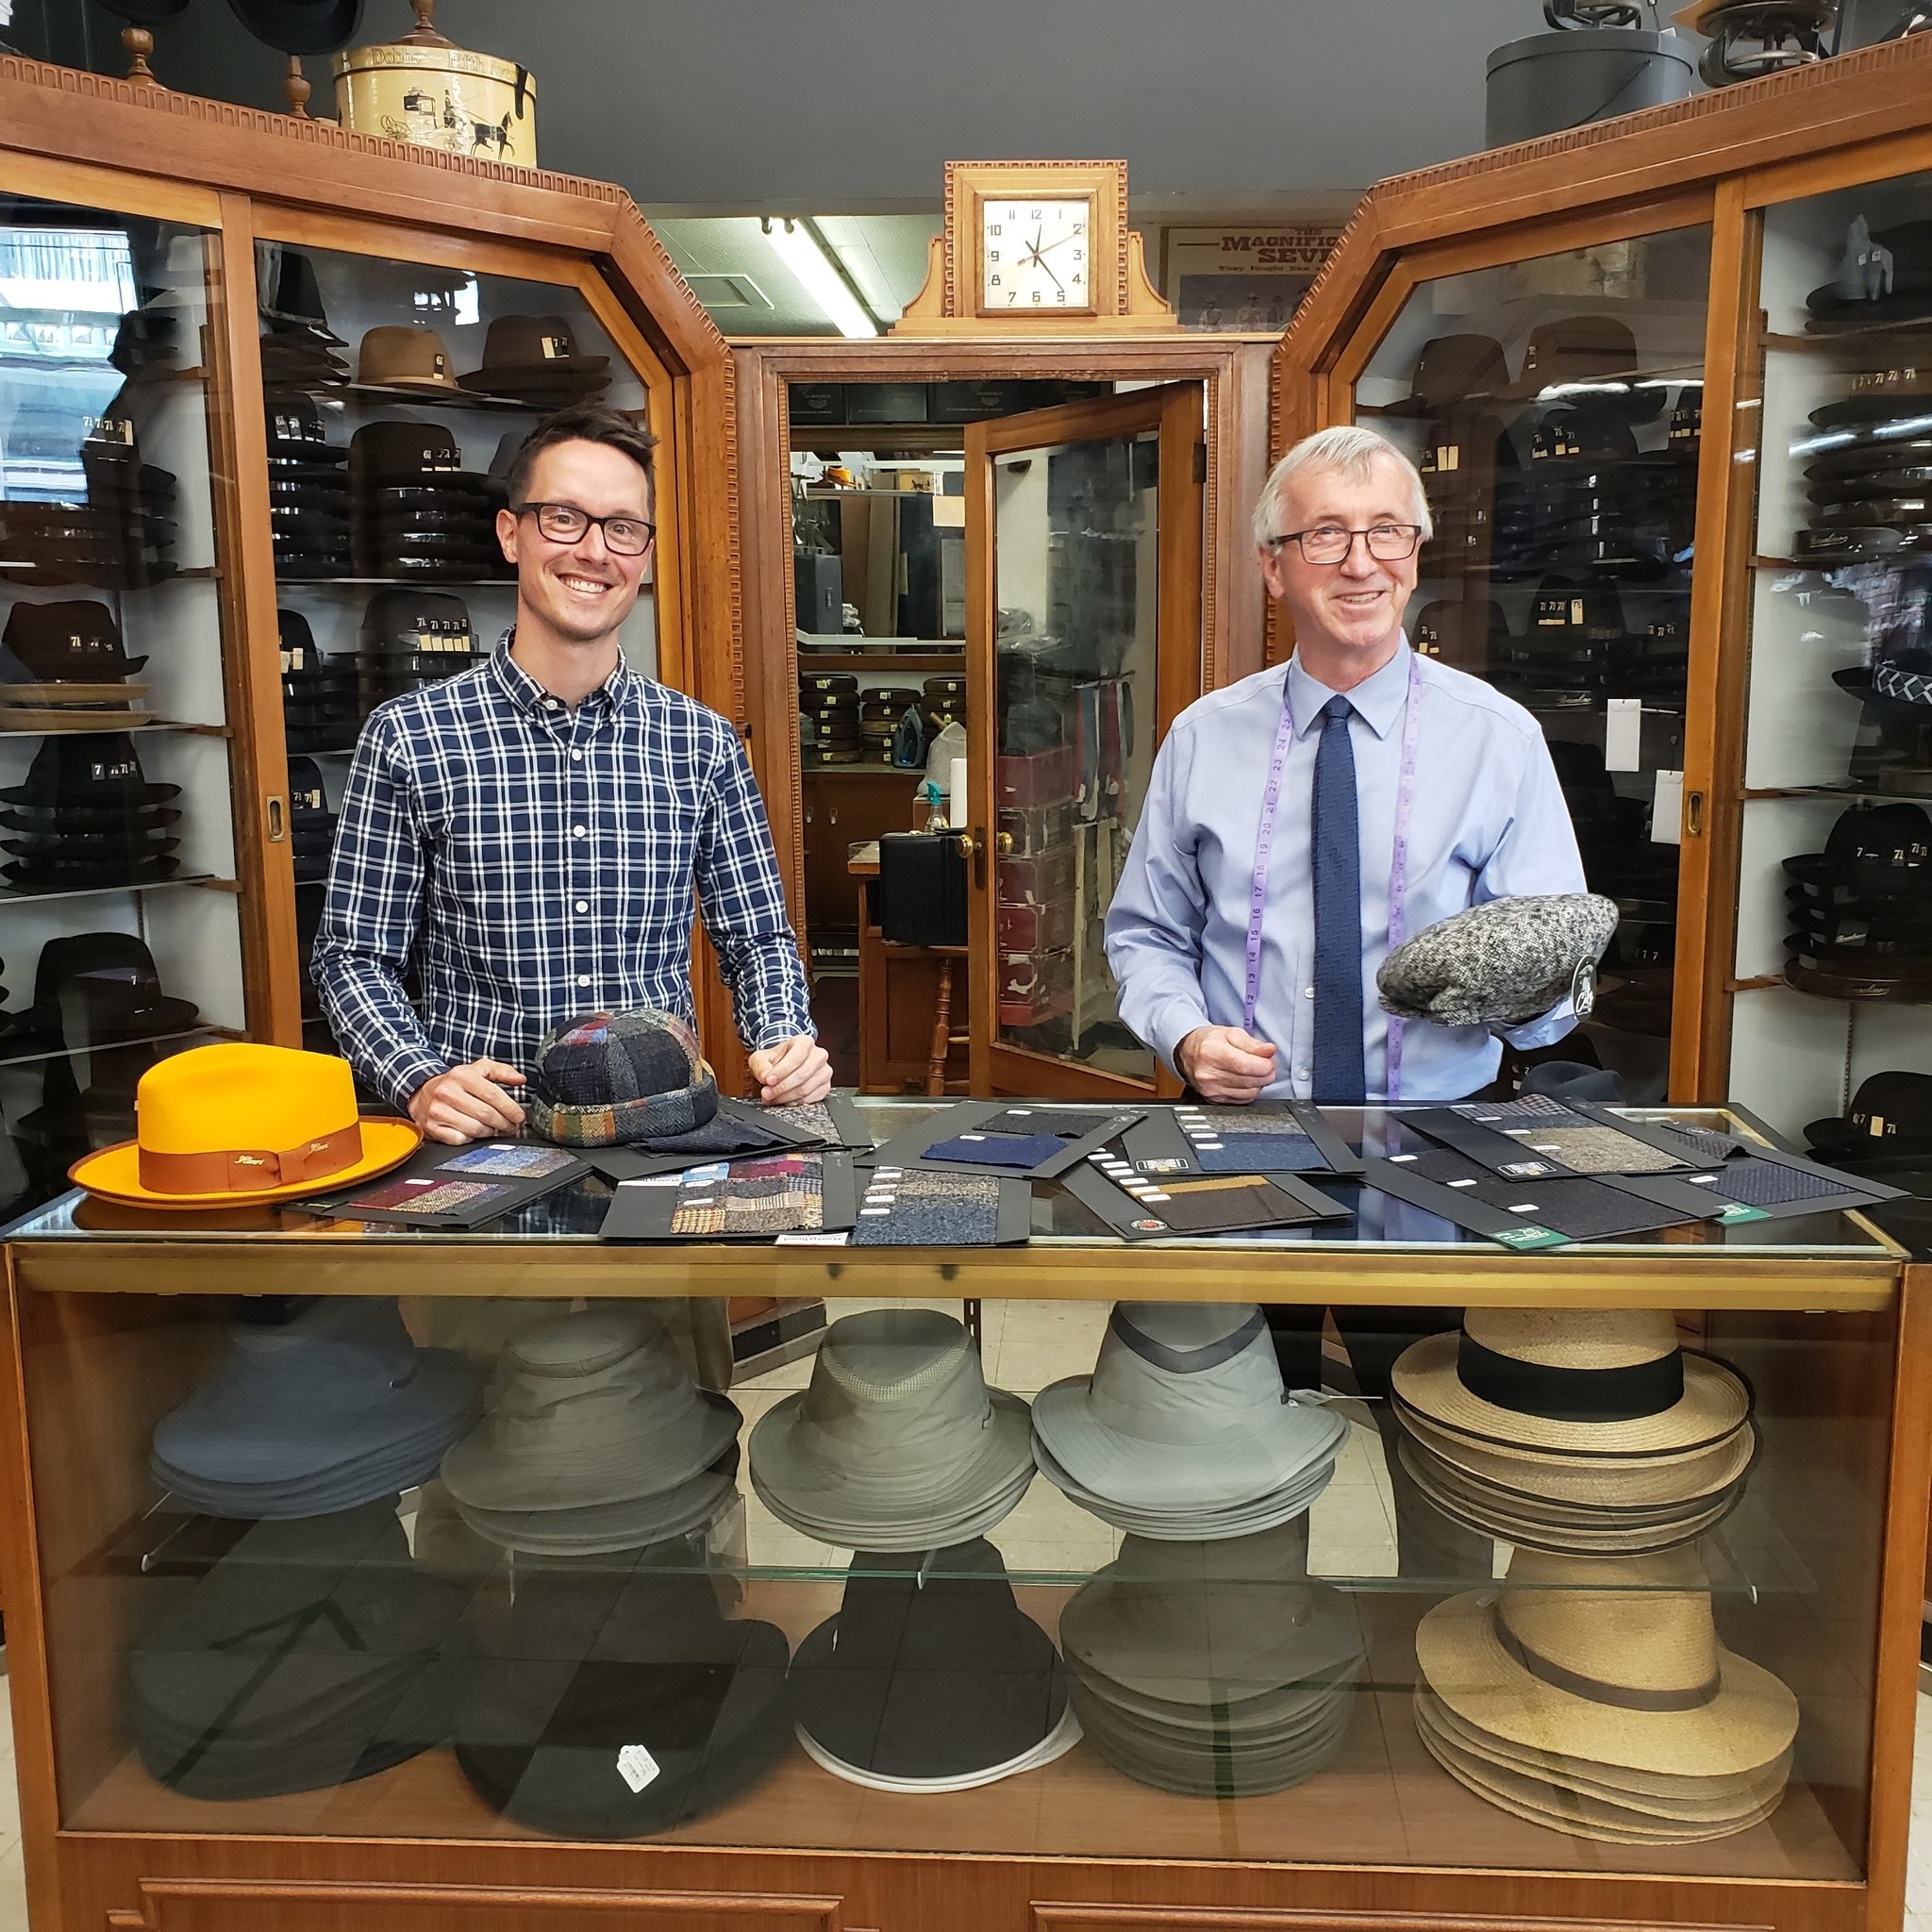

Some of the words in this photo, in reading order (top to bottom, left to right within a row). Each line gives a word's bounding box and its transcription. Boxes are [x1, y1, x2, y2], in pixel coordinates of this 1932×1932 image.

[371, 47, 422, 66] Dobbs
[1008, 209, 1015, 220] 11
[1031, 208, 1042, 220] 12
[1058, 208, 1062, 220] 1
[991, 225, 1002, 236] 10
[1073, 224, 1082, 235] 2
[991, 251, 1000, 262] 9
[1074, 249, 1082, 260] 3
[991, 275, 1001, 286] 8
[1072, 274, 1082, 284] 4
[1008, 291, 1017, 303] 7
[1032, 291, 1041, 303] 6
[1057, 291, 1065, 302] 5
[1276, 739, 1286, 751] 24
[1273, 758, 1282, 772] 23
[1269, 780, 1277, 792] 22
[1265, 802, 1274, 813] 21
[1262, 823, 1271, 835] 20
[1259, 843, 1268, 855] 19
[1255, 886, 1263, 898] 17
[1252, 908, 1260, 920] 16
[1250, 929, 1258, 941] 15
[1249, 952, 1256, 962] 14
[1248, 973, 1256, 984] 13
[1247, 994, 1254, 1006] 12
